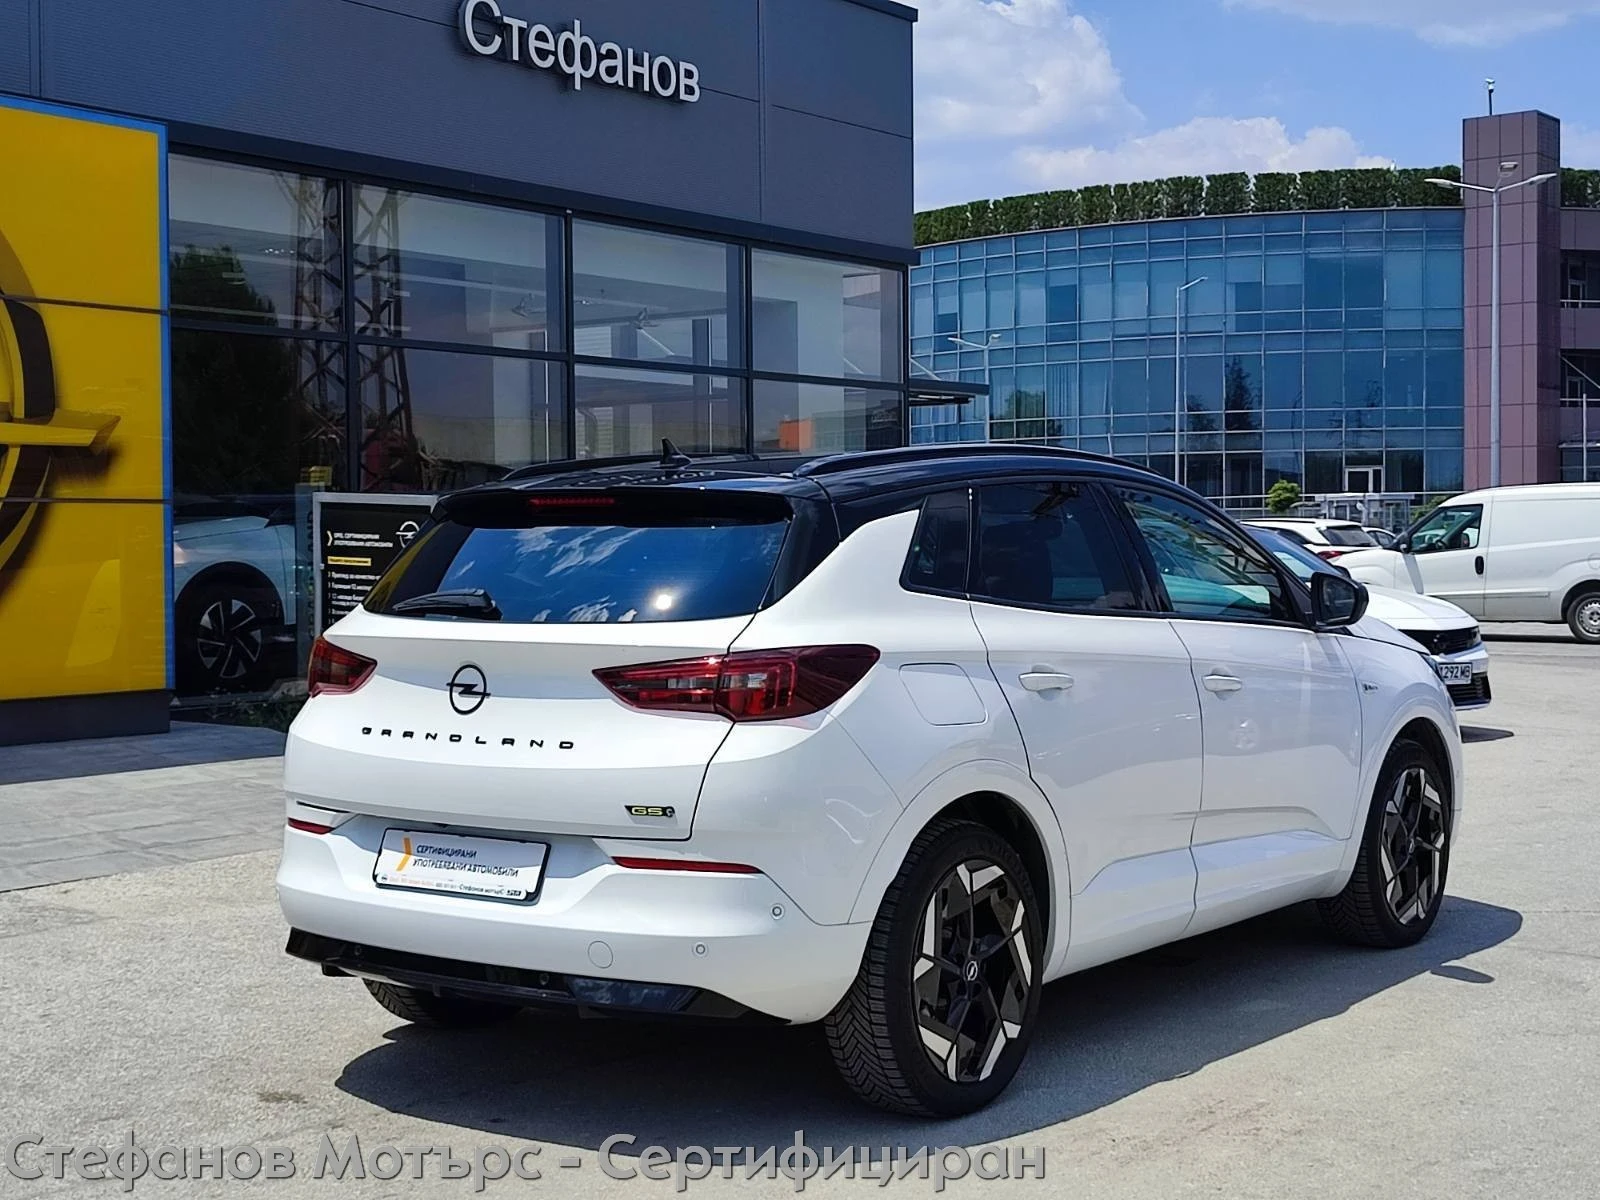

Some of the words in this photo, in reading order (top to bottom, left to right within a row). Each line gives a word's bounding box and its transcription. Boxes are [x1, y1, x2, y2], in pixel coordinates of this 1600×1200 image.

[464, 0, 700, 102] Стефанов
[362, 727, 574, 750] GRANDLAND
[416, 844, 478, 859] СЕРТИФИЦИРАНИ
[467, 864, 519, 877] АВТОМОБИЛИ
